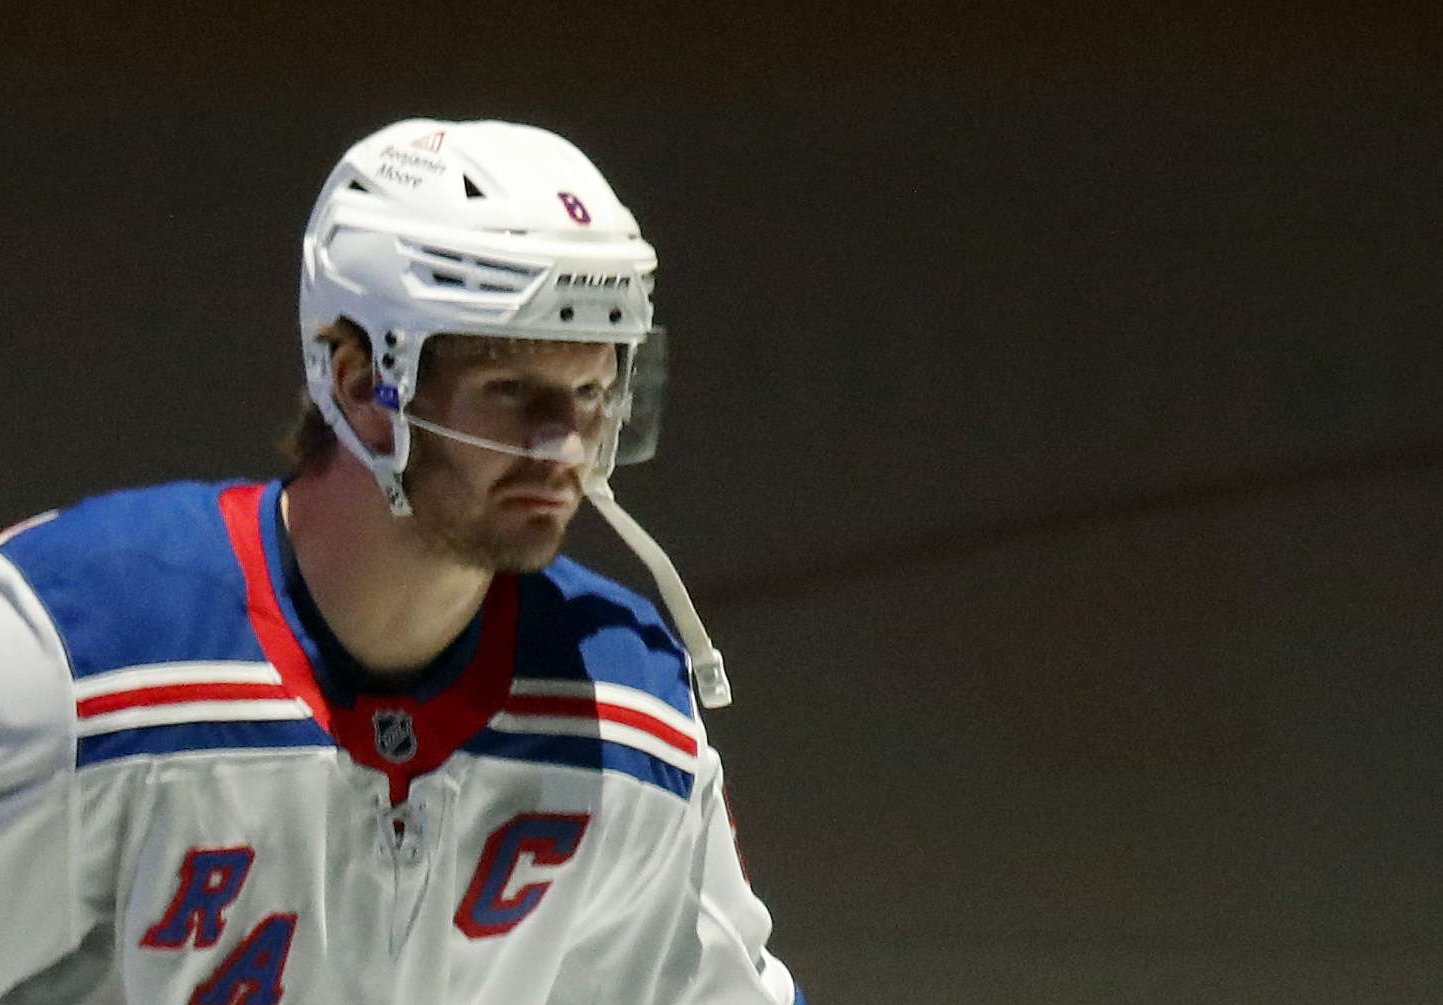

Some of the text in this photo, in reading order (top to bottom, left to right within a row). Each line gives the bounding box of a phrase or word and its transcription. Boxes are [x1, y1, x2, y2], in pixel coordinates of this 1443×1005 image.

[557, 192, 592, 225] 8
[556, 273, 631, 290] BAUER
[453, 812, 592, 940] C
